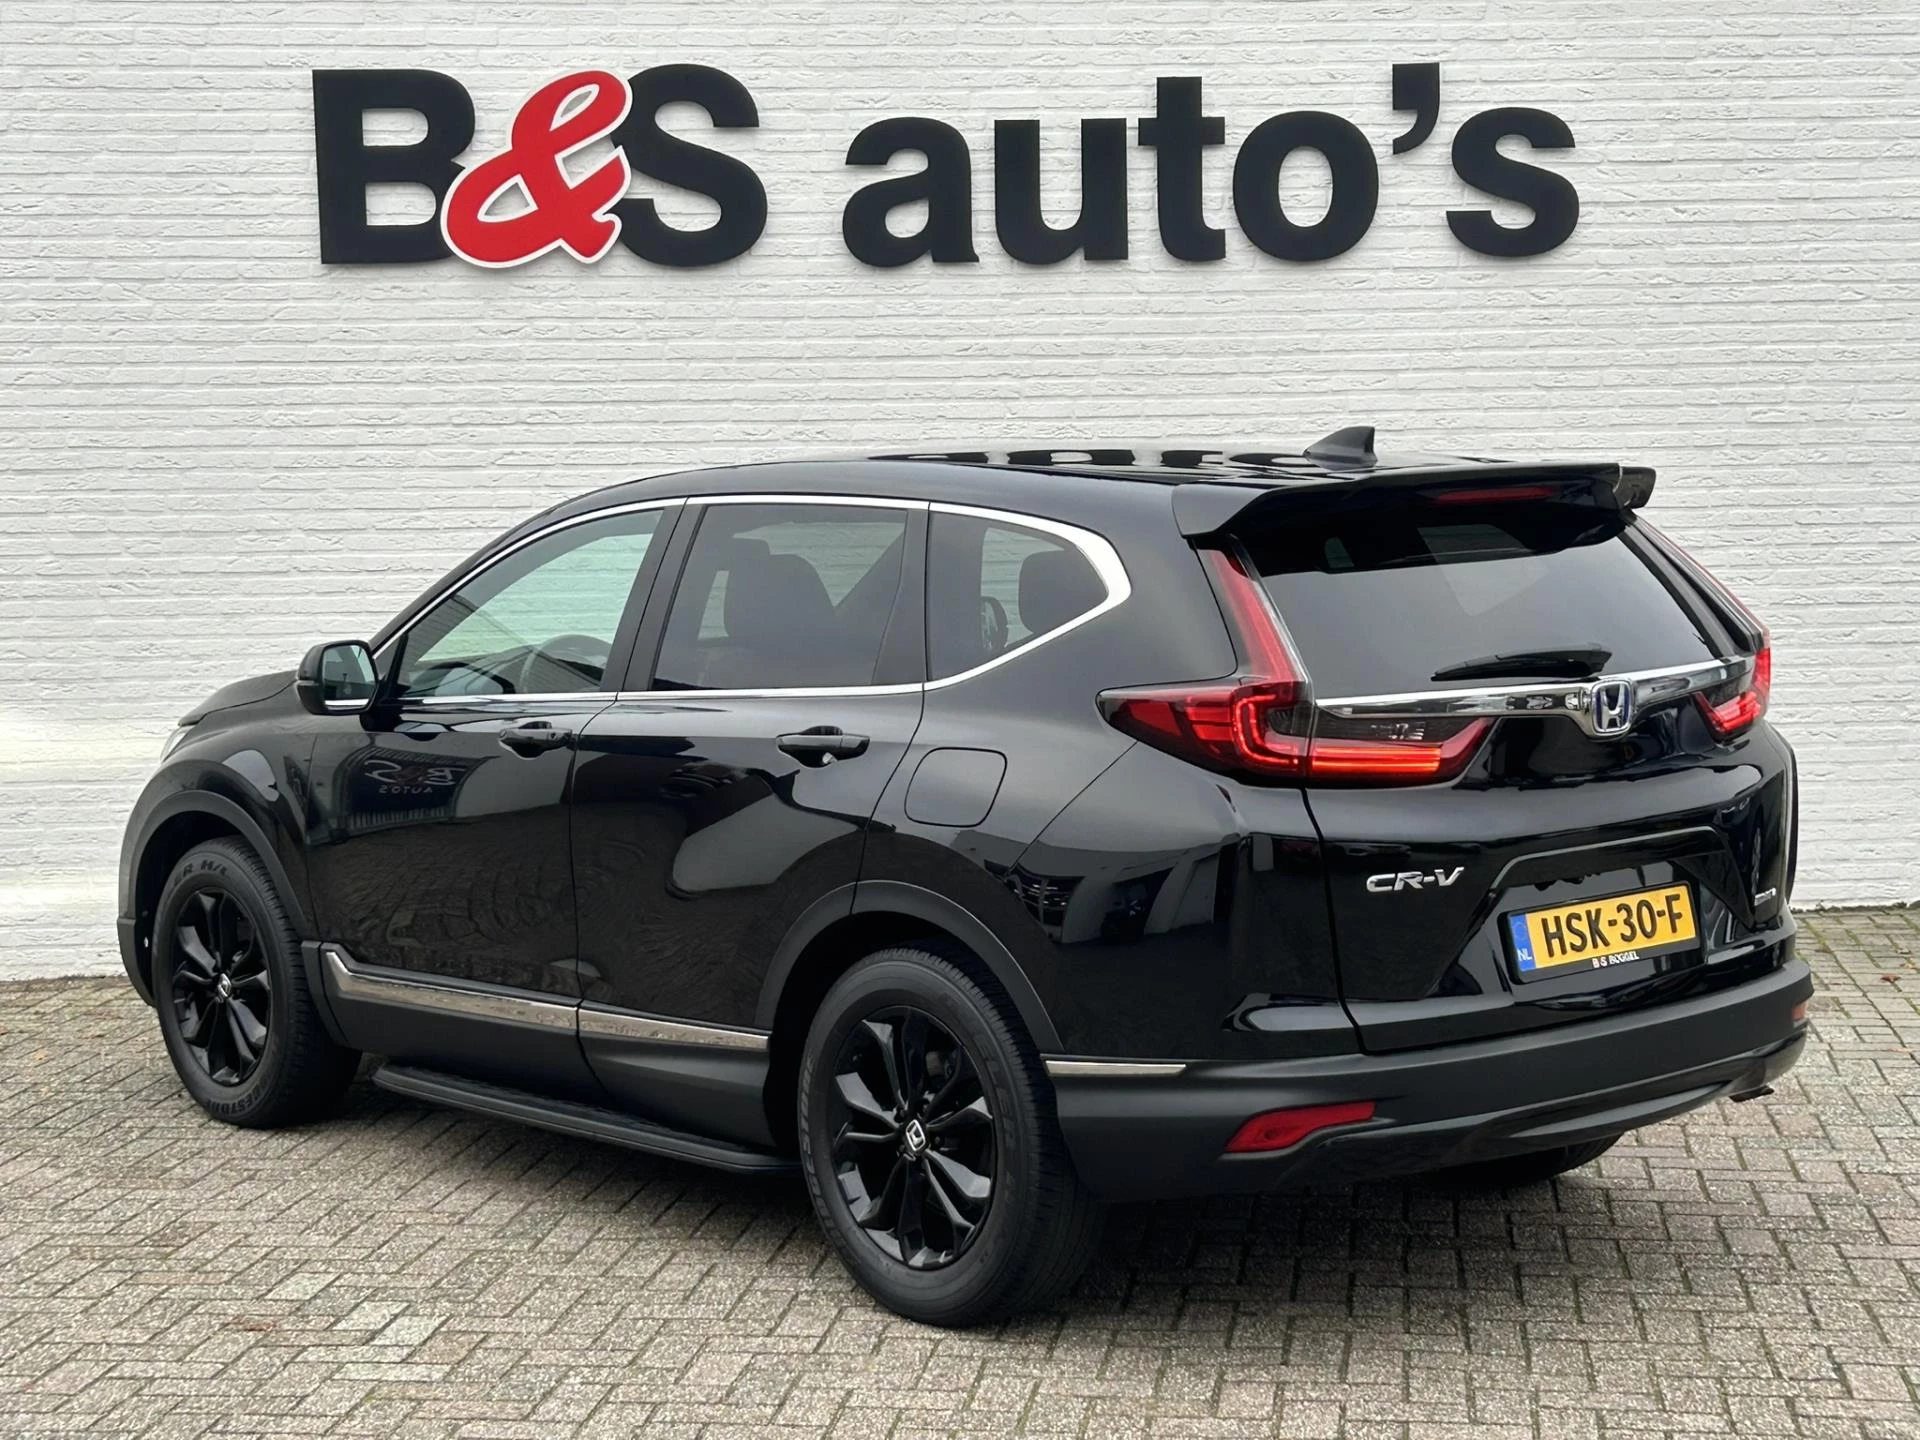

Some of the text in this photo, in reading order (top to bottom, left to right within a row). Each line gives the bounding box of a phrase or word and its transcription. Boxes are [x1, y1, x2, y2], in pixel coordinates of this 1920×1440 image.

[313, 63, 1580, 269] B&S auto's
[1366, 866, 1465, 893] CR-V
[1541, 893, 1683, 958] HSK-30-F
[1517, 949, 1533, 961] NL
